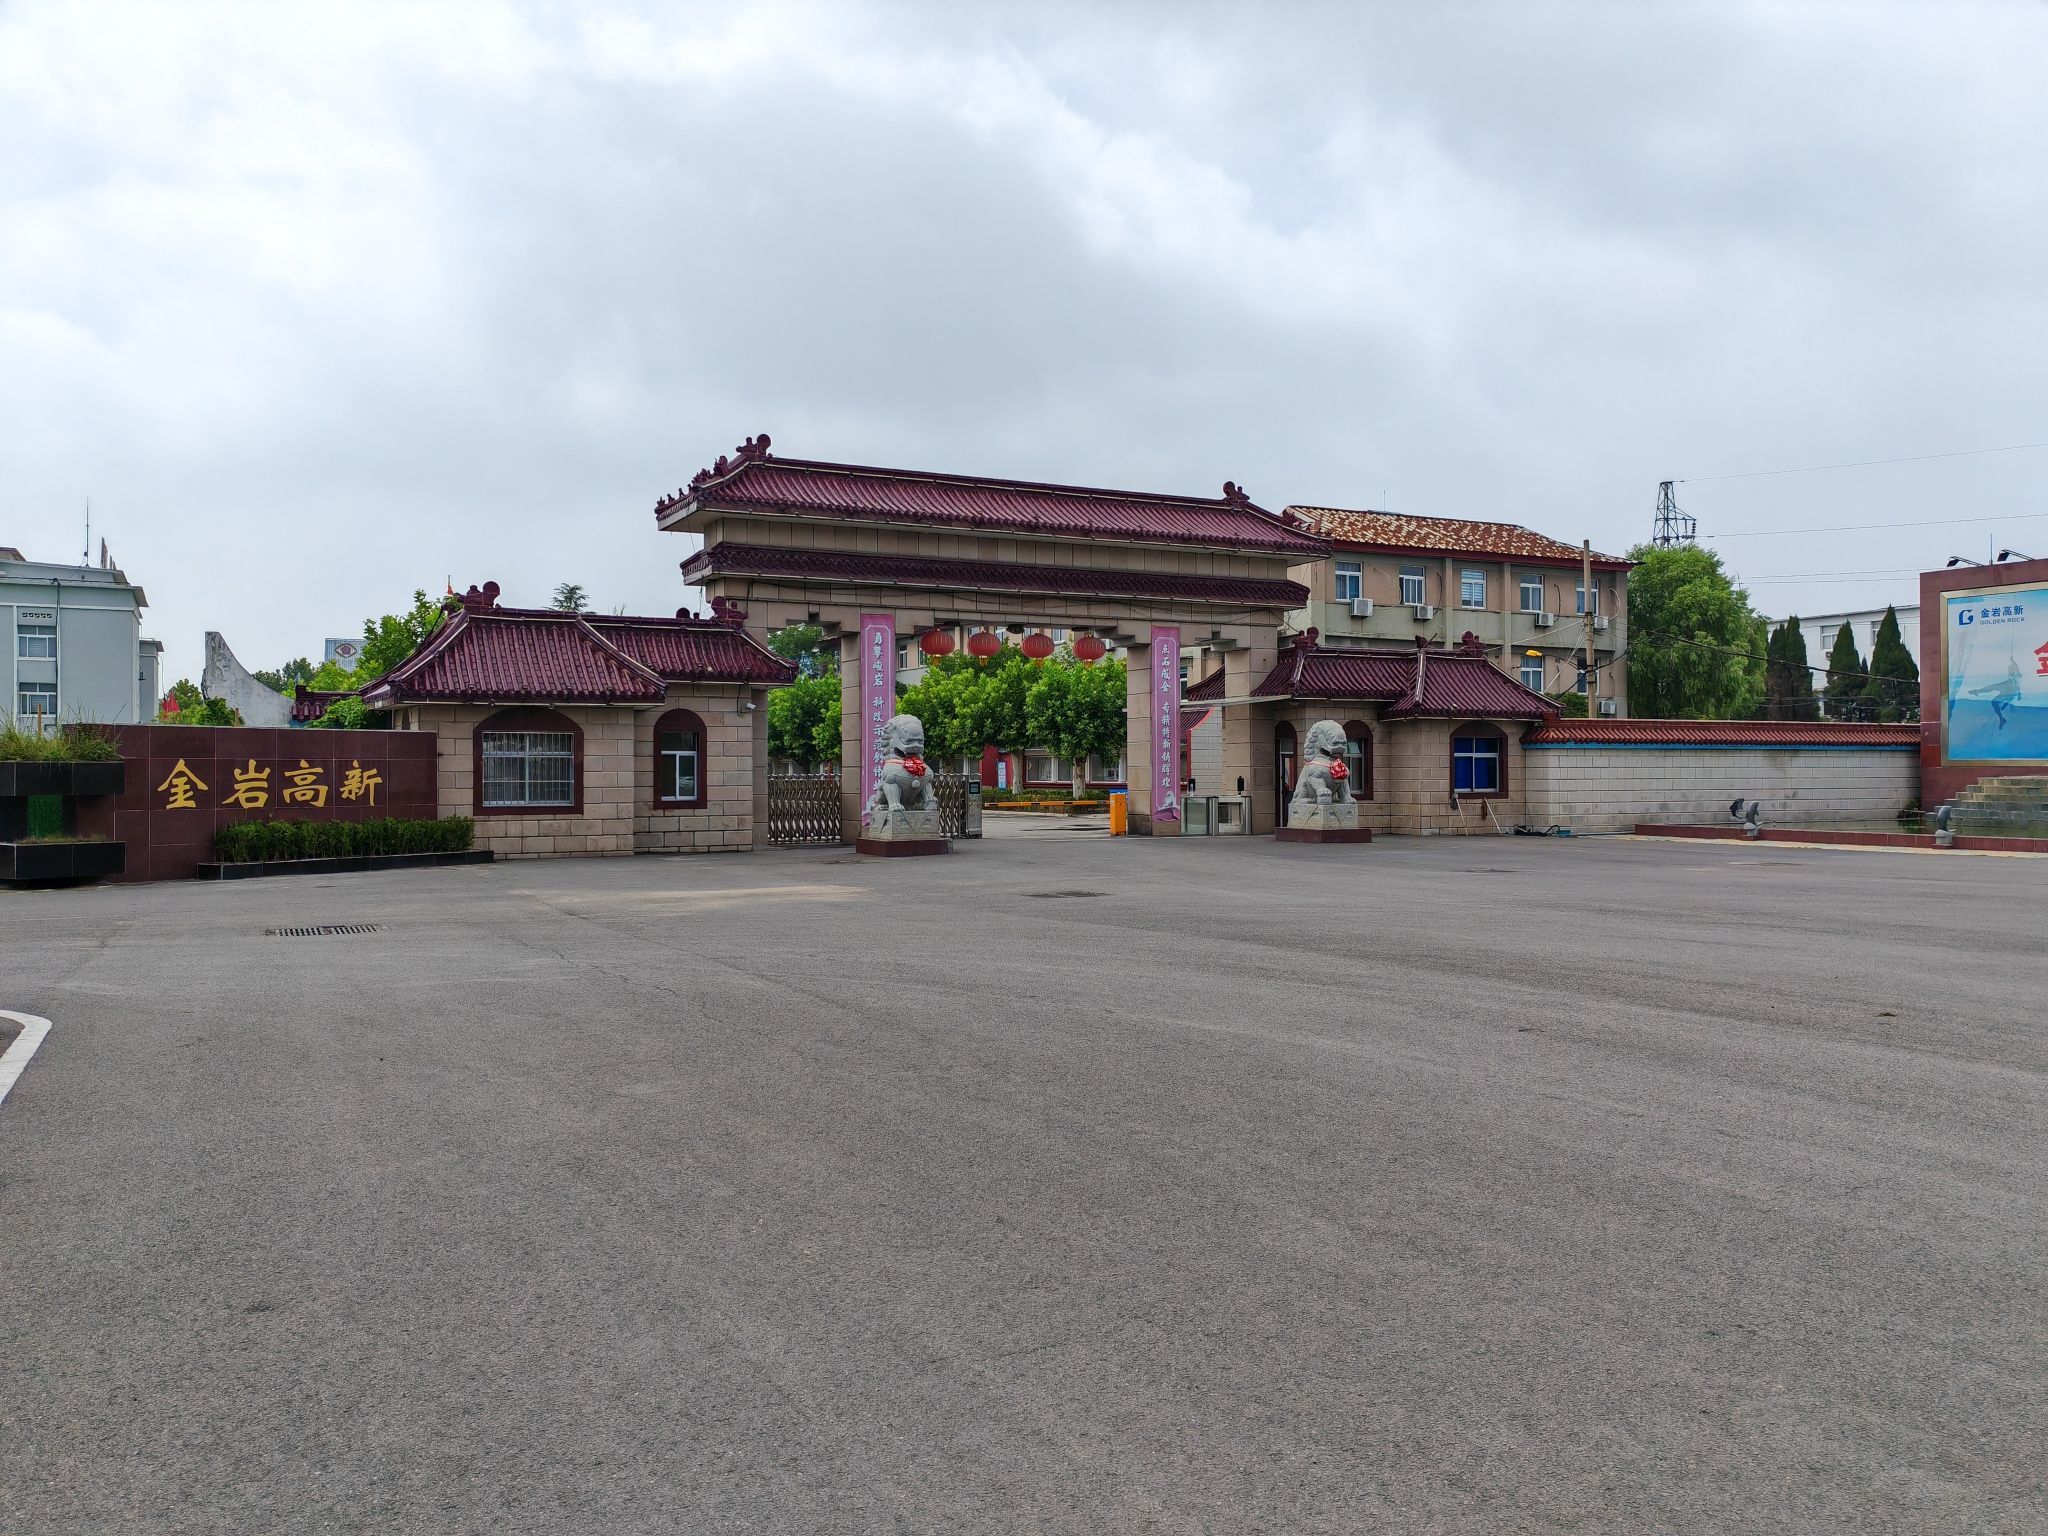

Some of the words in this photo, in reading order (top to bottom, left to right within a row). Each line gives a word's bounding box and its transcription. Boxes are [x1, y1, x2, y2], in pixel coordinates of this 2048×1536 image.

[1980, 605, 2024, 618] 金岩高新
[1980, 618, 2006, 626] GOLDEN
[873, 631, 884, 687] 勇攀峻岩
[1160, 643, 1172, 693] 点石成金
[1161, 701, 1172, 788] 专精特新铸辉煌
[157, 758, 383, 810] 金岩高新
